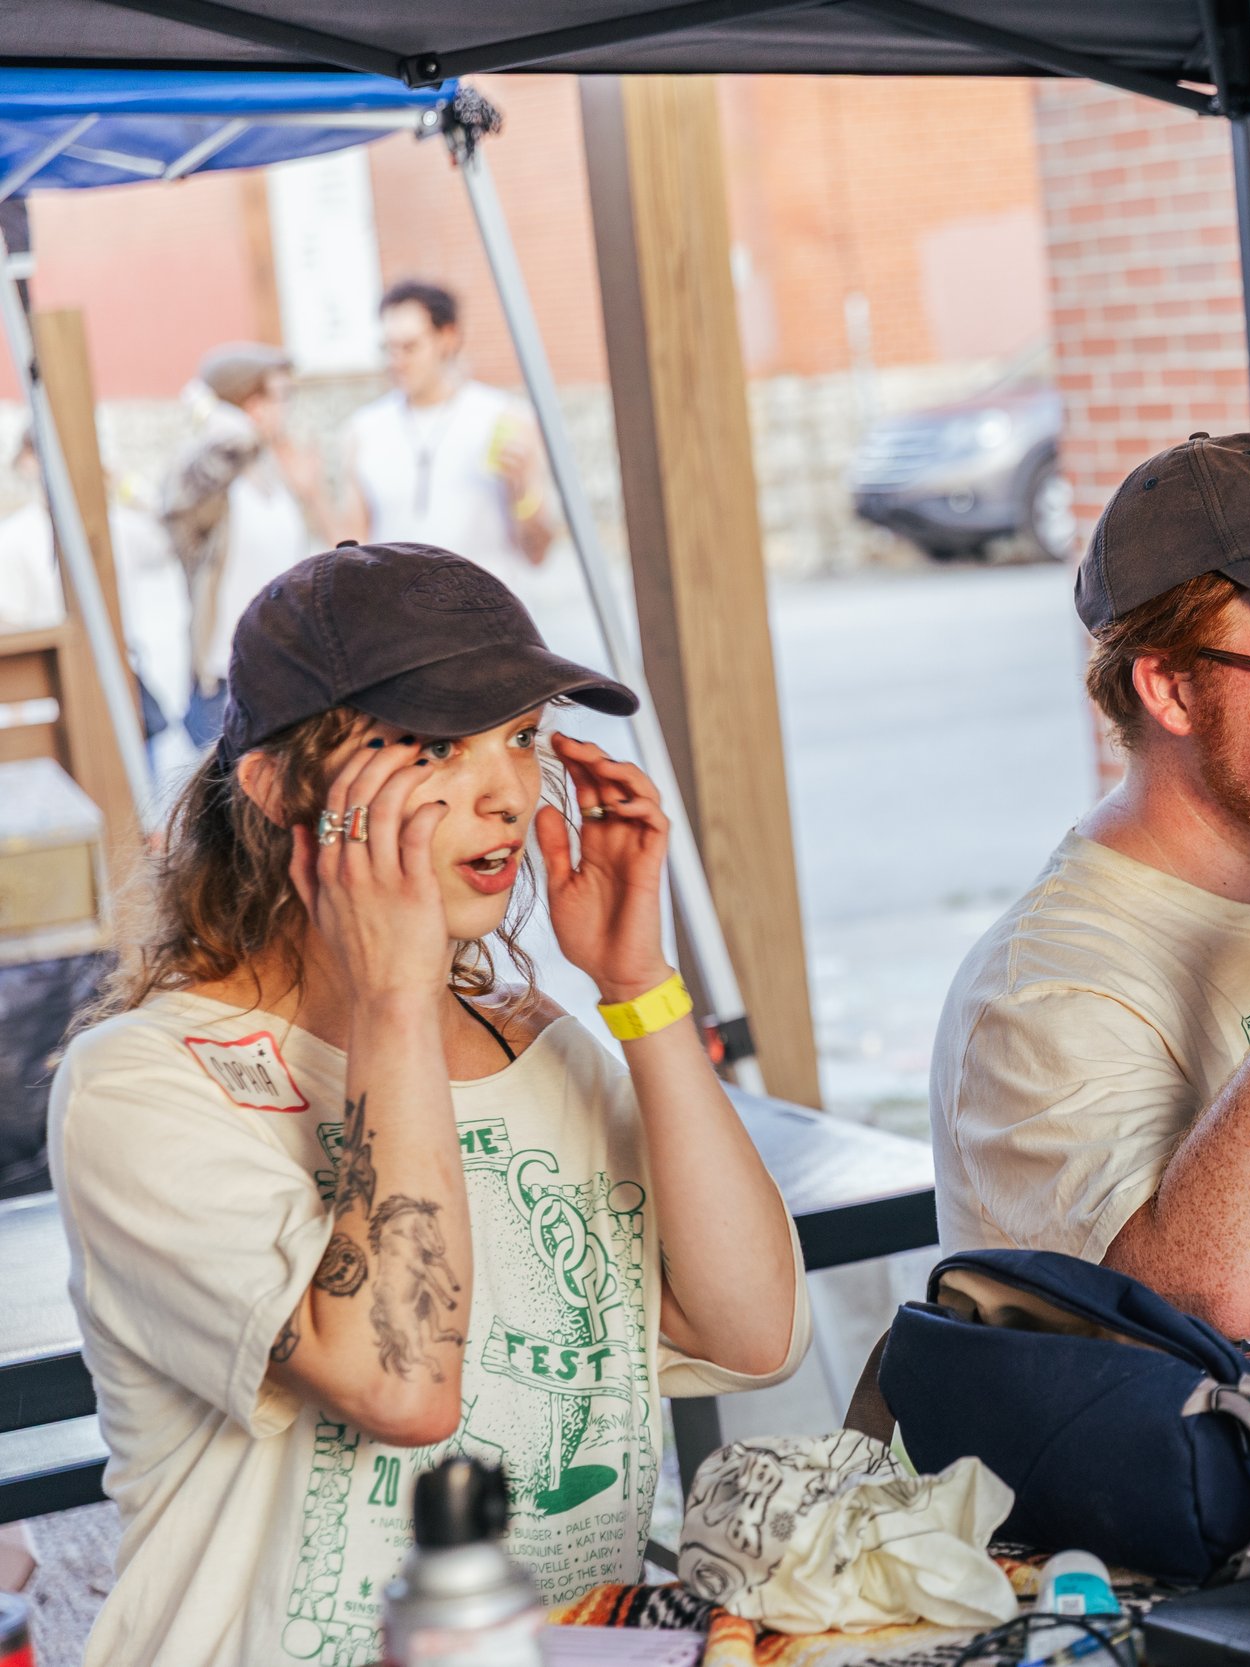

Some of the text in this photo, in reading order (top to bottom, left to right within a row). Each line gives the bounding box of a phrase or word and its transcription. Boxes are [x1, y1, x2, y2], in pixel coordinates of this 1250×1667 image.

[459, 1127, 500, 1155] HE
[505, 1331, 615, 1382] FEST
[368, 1455, 401, 1507] 20
[379, 1517, 416, 1531] NATUR
[566, 1517, 592, 1536] PALE
[594, 1511, 626, 1526] TONG
[576, 1532, 597, 1549] KAT
[529, 1558, 571, 1574] OVELLE
[535, 1562, 617, 1590] ERS OF THE SKY
[552, 1581, 600, 1605] MOOR
[343, 1600, 383, 1616] SINS
